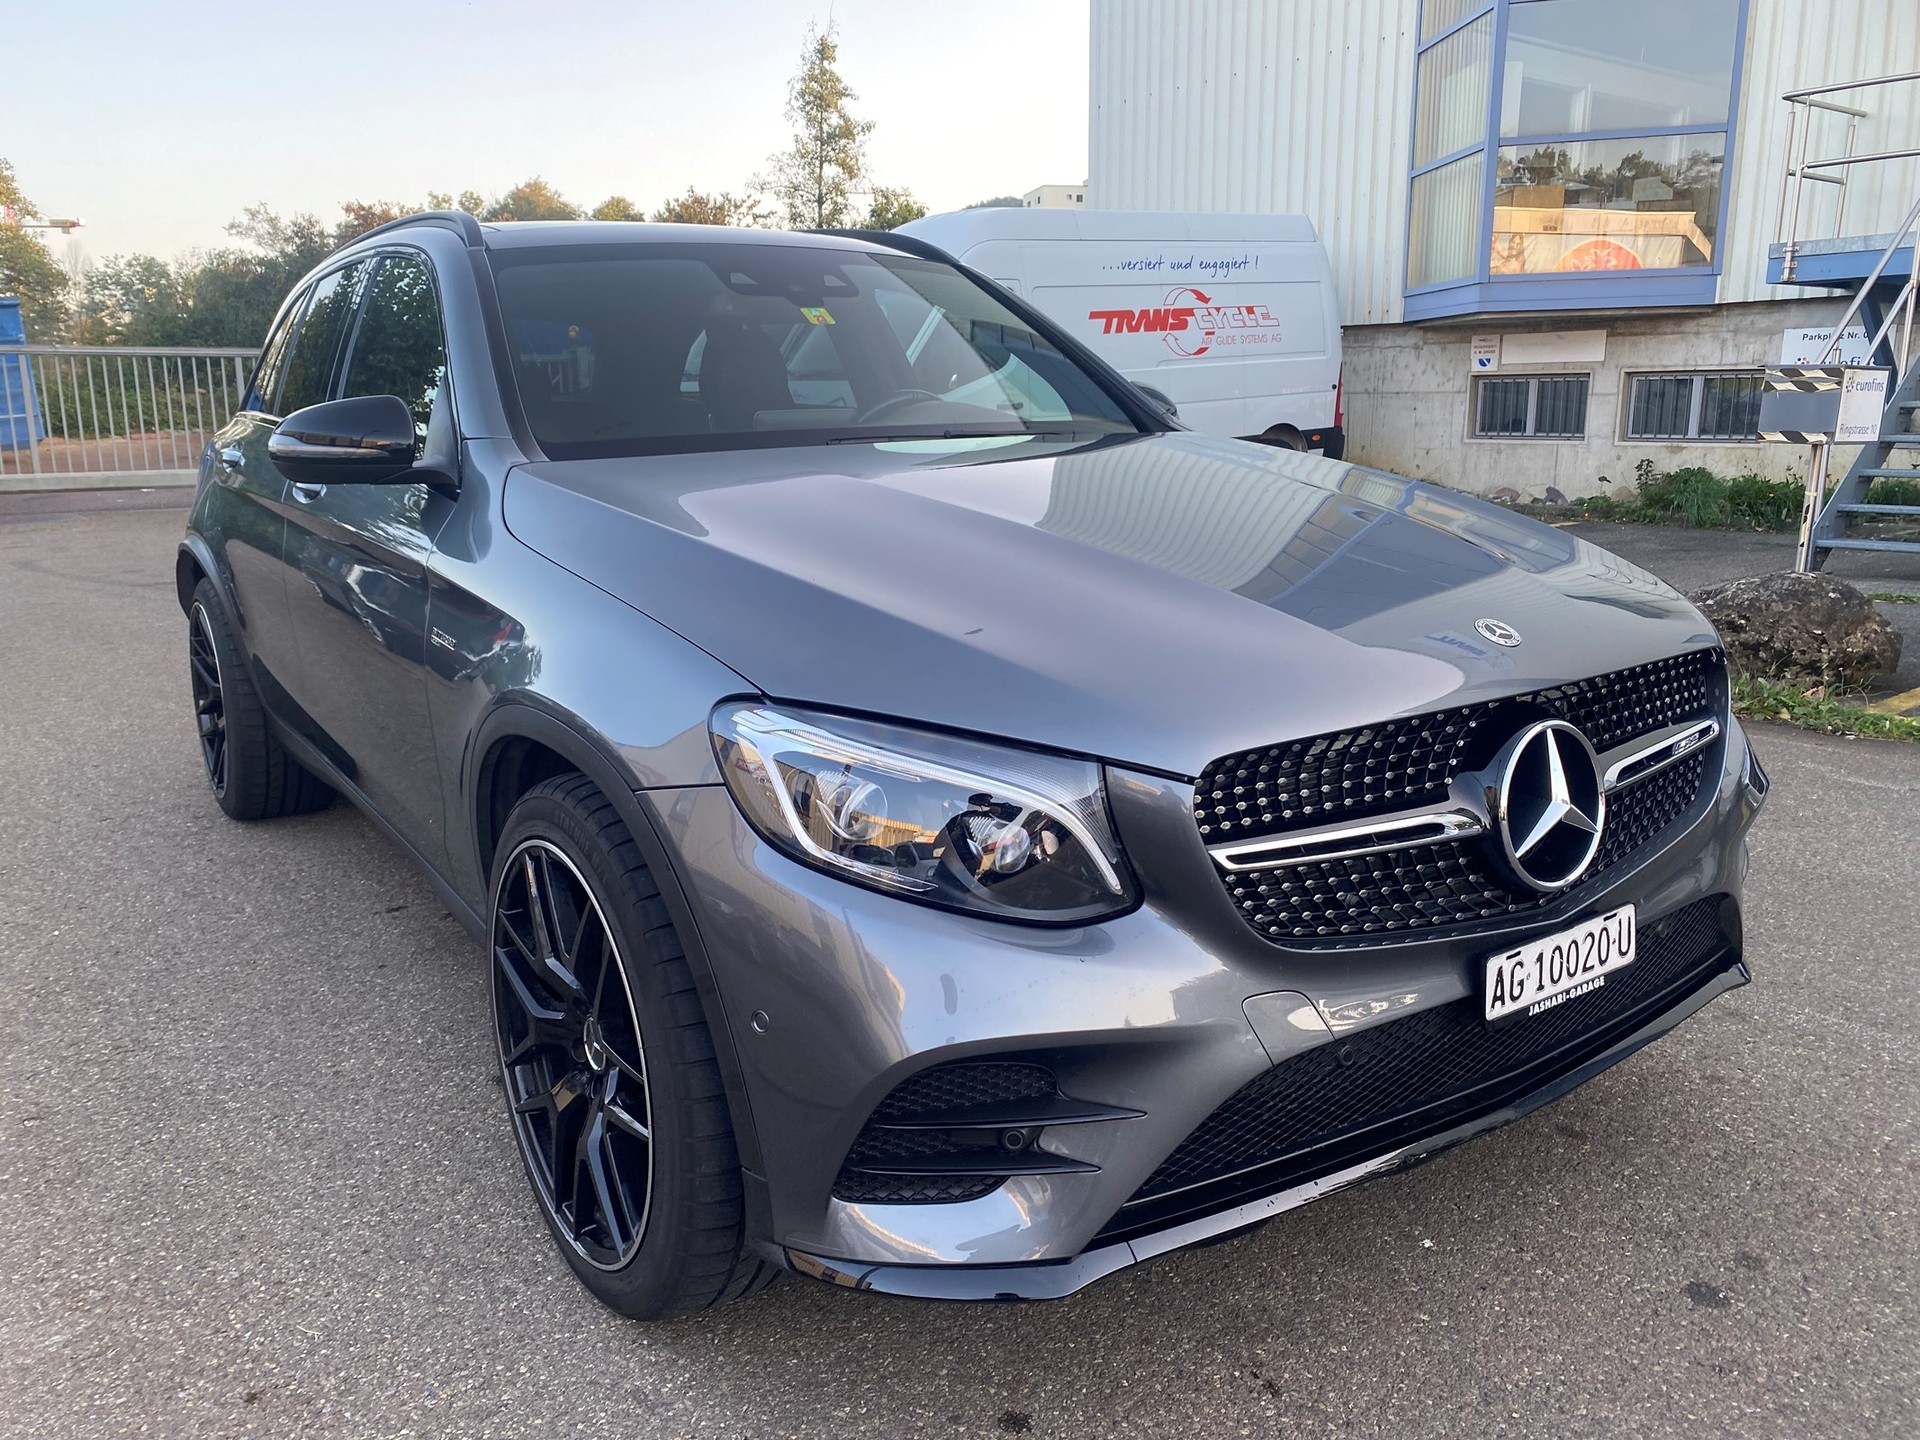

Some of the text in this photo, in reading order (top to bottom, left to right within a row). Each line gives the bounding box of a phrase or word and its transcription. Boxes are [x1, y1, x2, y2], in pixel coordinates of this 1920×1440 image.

[1170, 255, 1194, 271] und
[1199, 254, 1250, 278] engagiert
[1201, 337, 1212, 346] AIR
[1240, 334, 1268, 344] SYSTEMS
[1271, 333, 1282, 343] AG
[1802, 332, 1844, 342] Parkplz
[1847, 331, 1860, 339] Nr.
[1855, 377, 1884, 392] eurofins
[1528, 975, 1606, 1016] JASHARI-GARAGE
